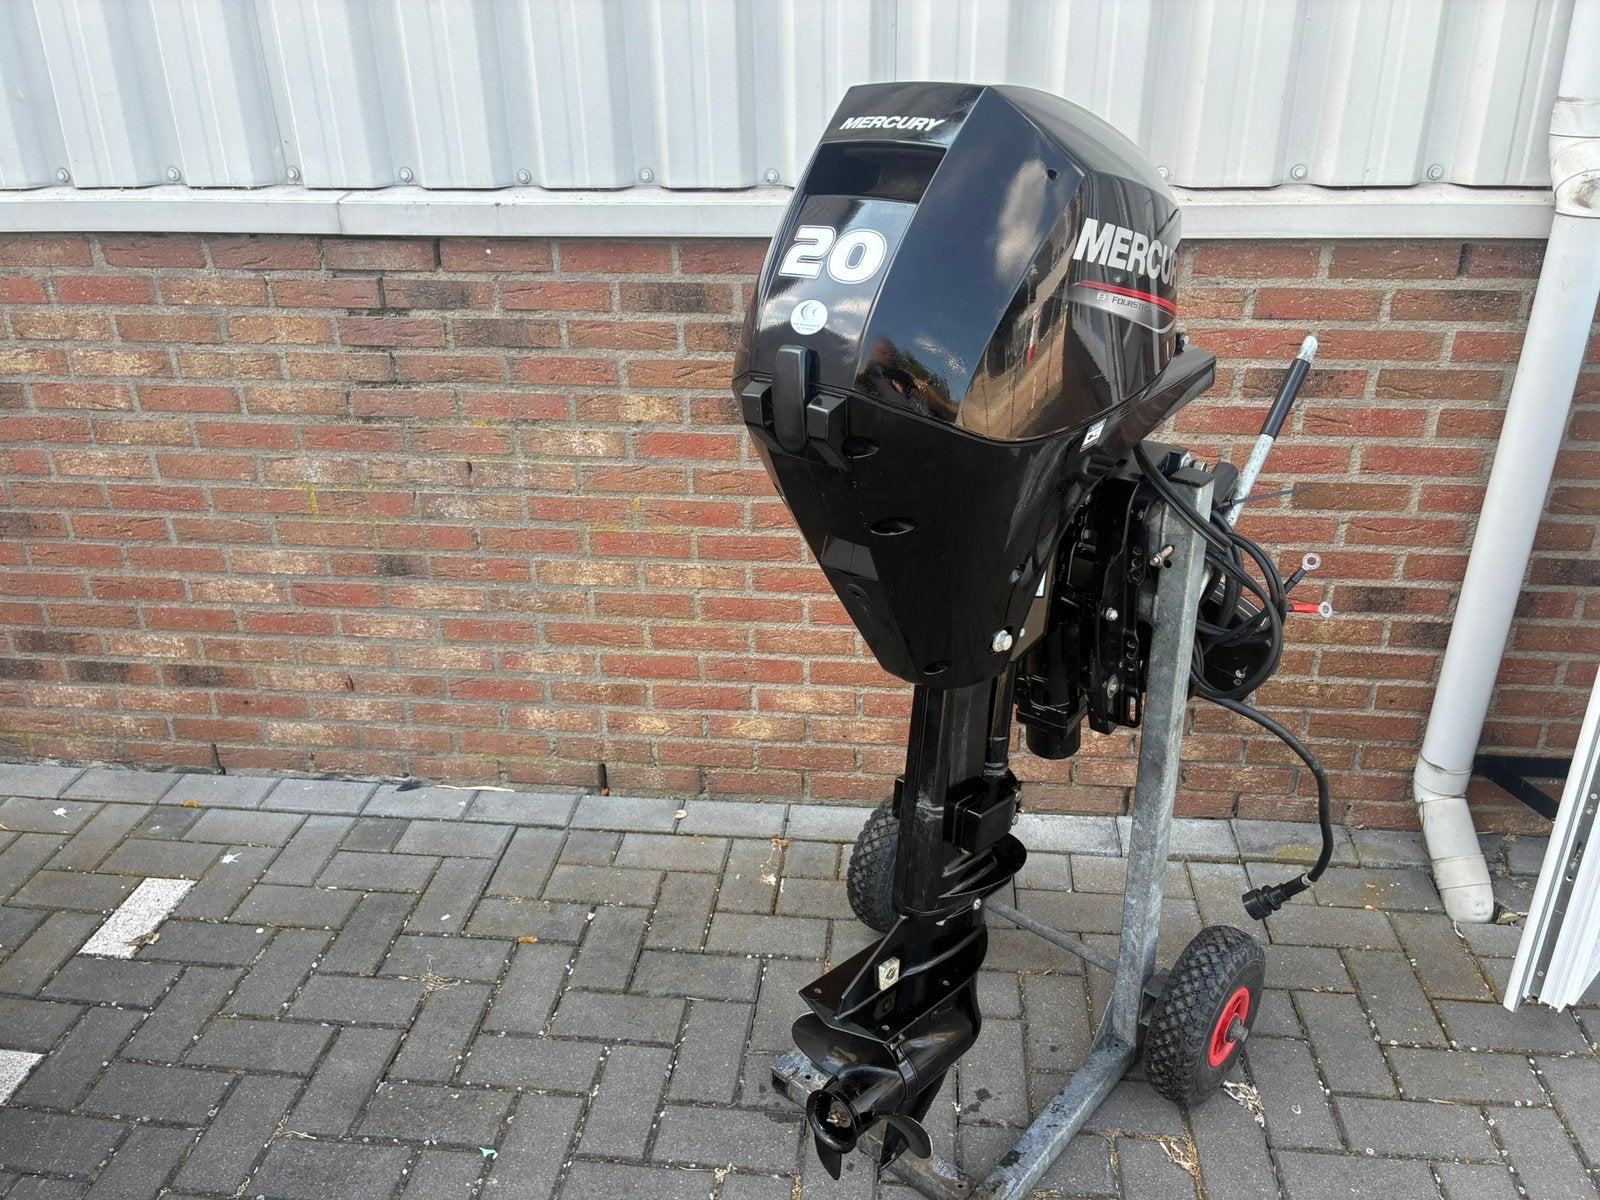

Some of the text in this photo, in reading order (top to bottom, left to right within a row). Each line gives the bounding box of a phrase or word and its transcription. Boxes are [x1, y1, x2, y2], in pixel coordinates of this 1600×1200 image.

[839, 116, 945, 131] MERCURY
[779, 225, 887, 284] 20
[1073, 218, 1177, 287] MERCUR
